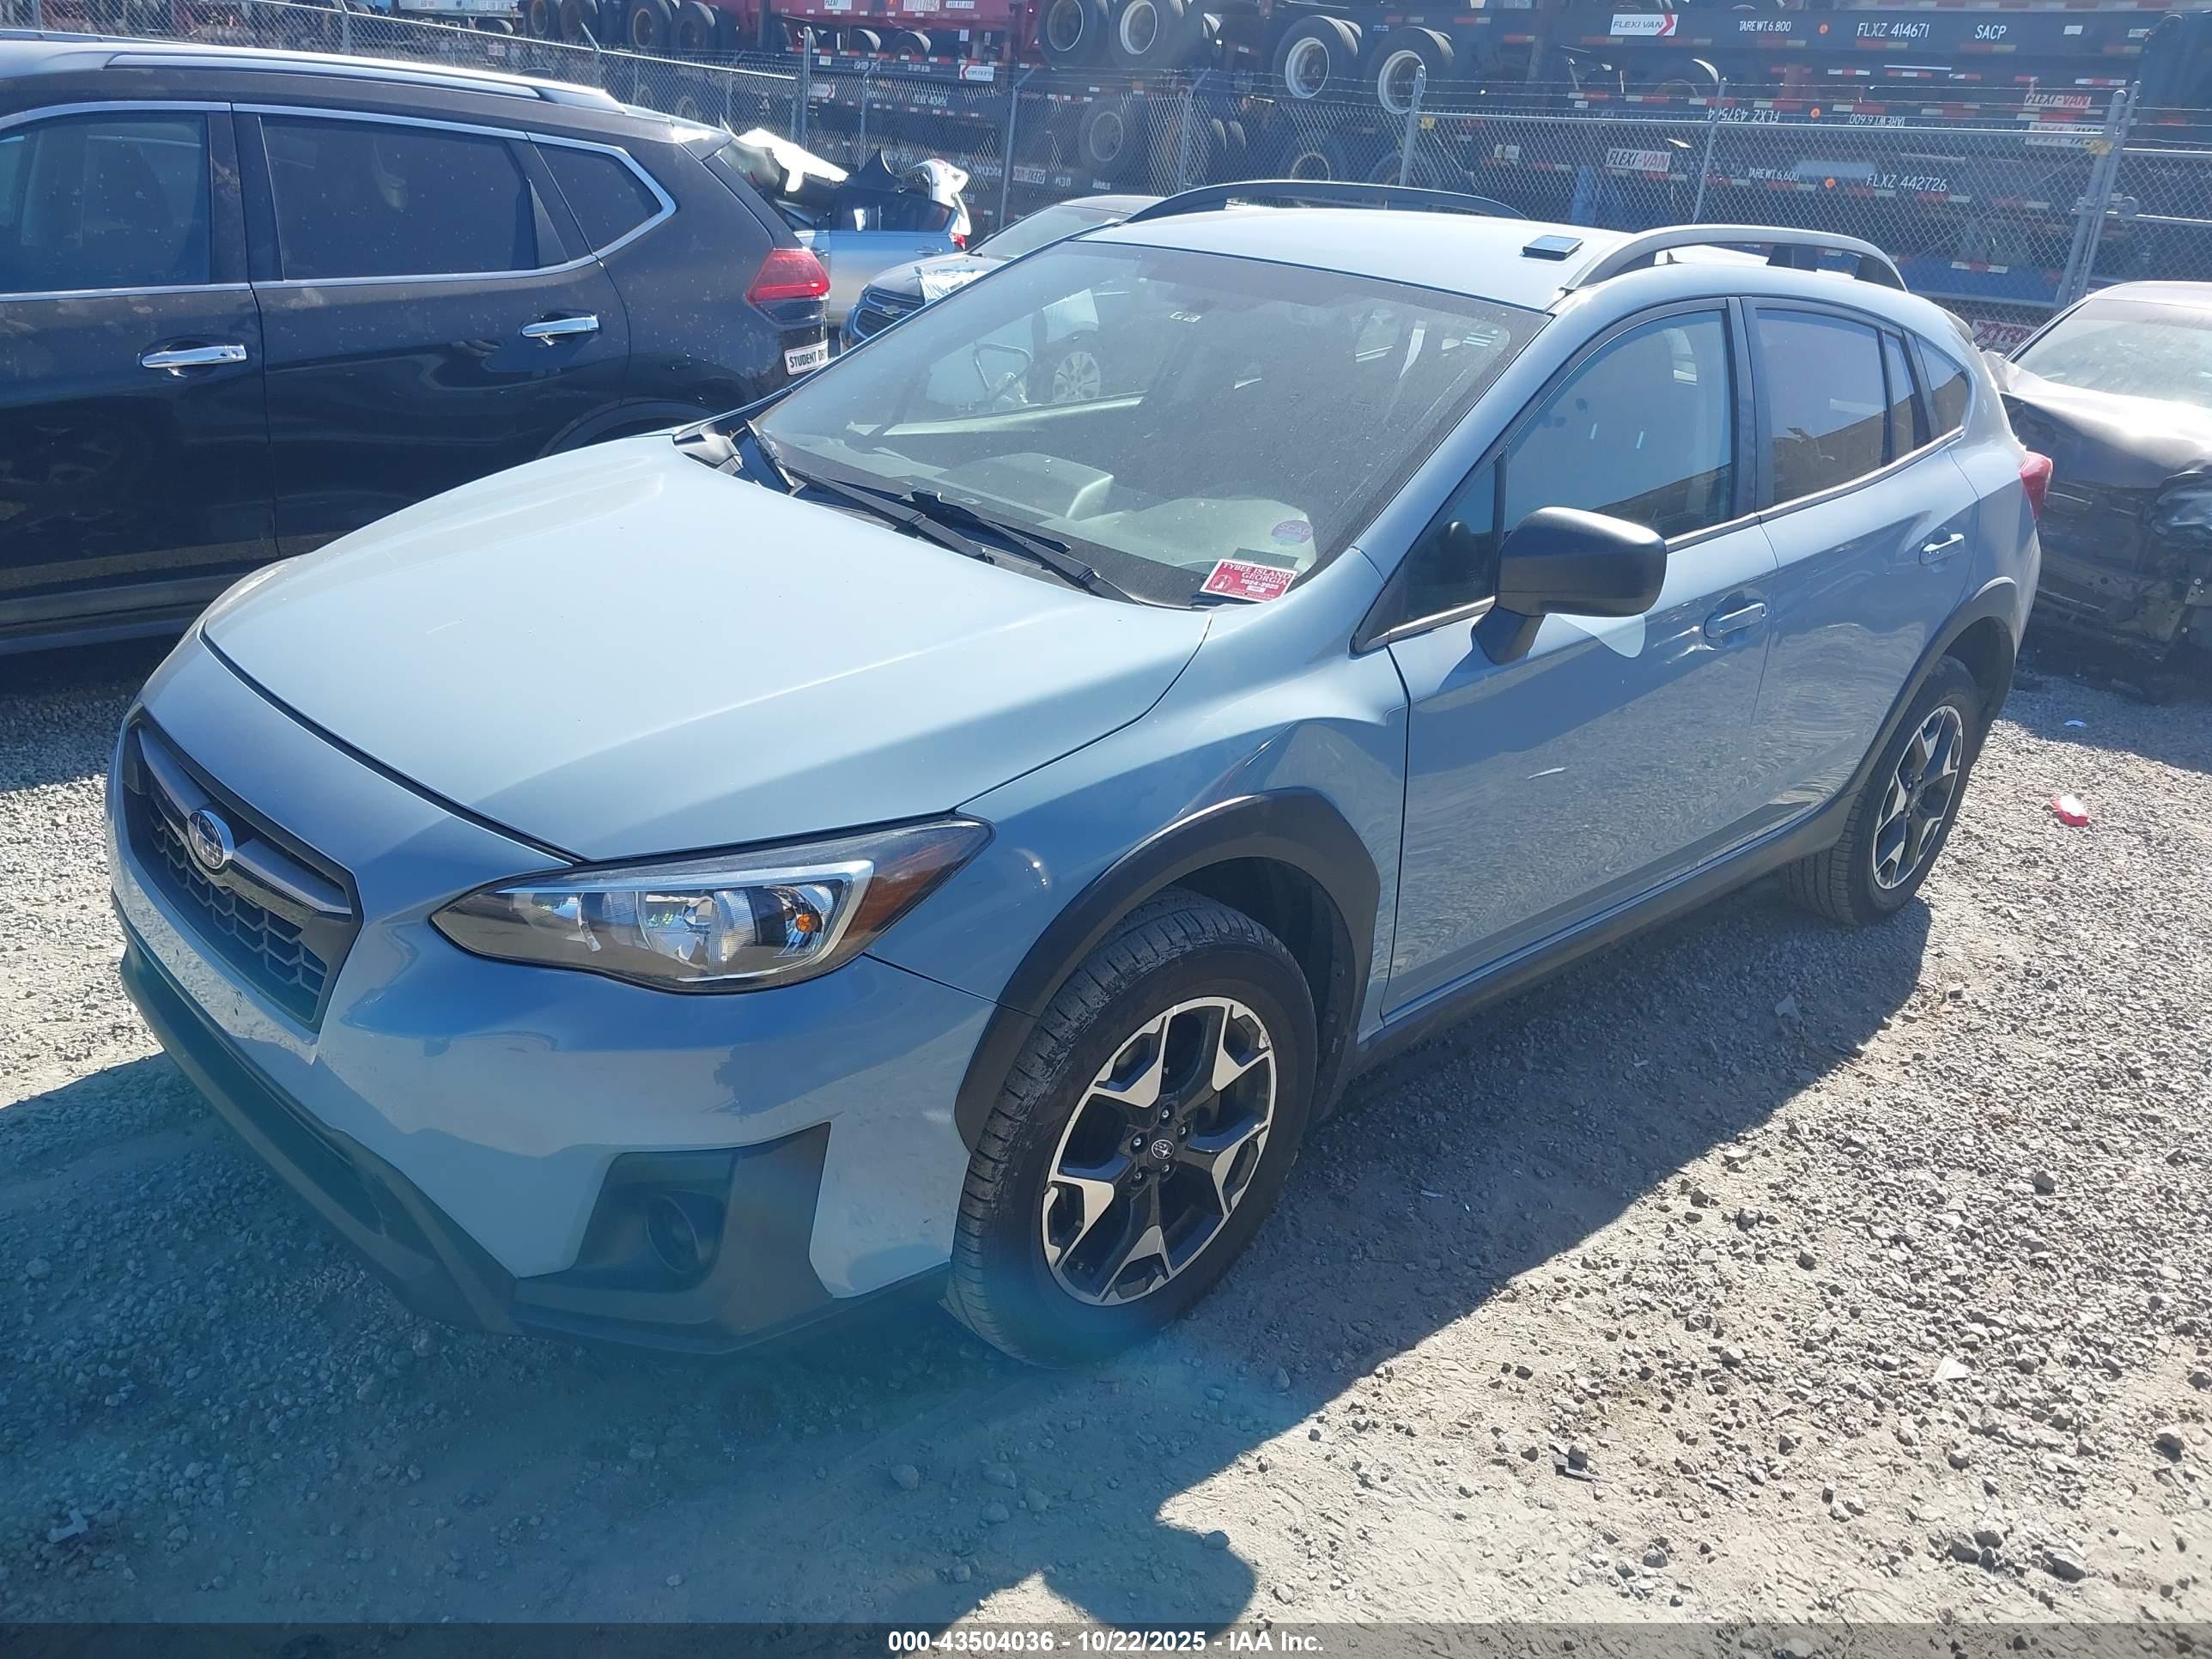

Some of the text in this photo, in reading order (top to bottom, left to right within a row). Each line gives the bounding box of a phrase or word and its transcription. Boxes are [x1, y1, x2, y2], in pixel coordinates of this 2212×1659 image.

[1856, 22, 1930, 39] FLXZ 414671
[1974, 24, 2007, 40] SACP
[1866, 173, 1948, 192] FLXZ 442726
[789, 351, 817, 368] STUDENT
[1223, 562, 1291, 580] TYBEE ISLAND
[1242, 572, 1286, 585] GEORGIA
